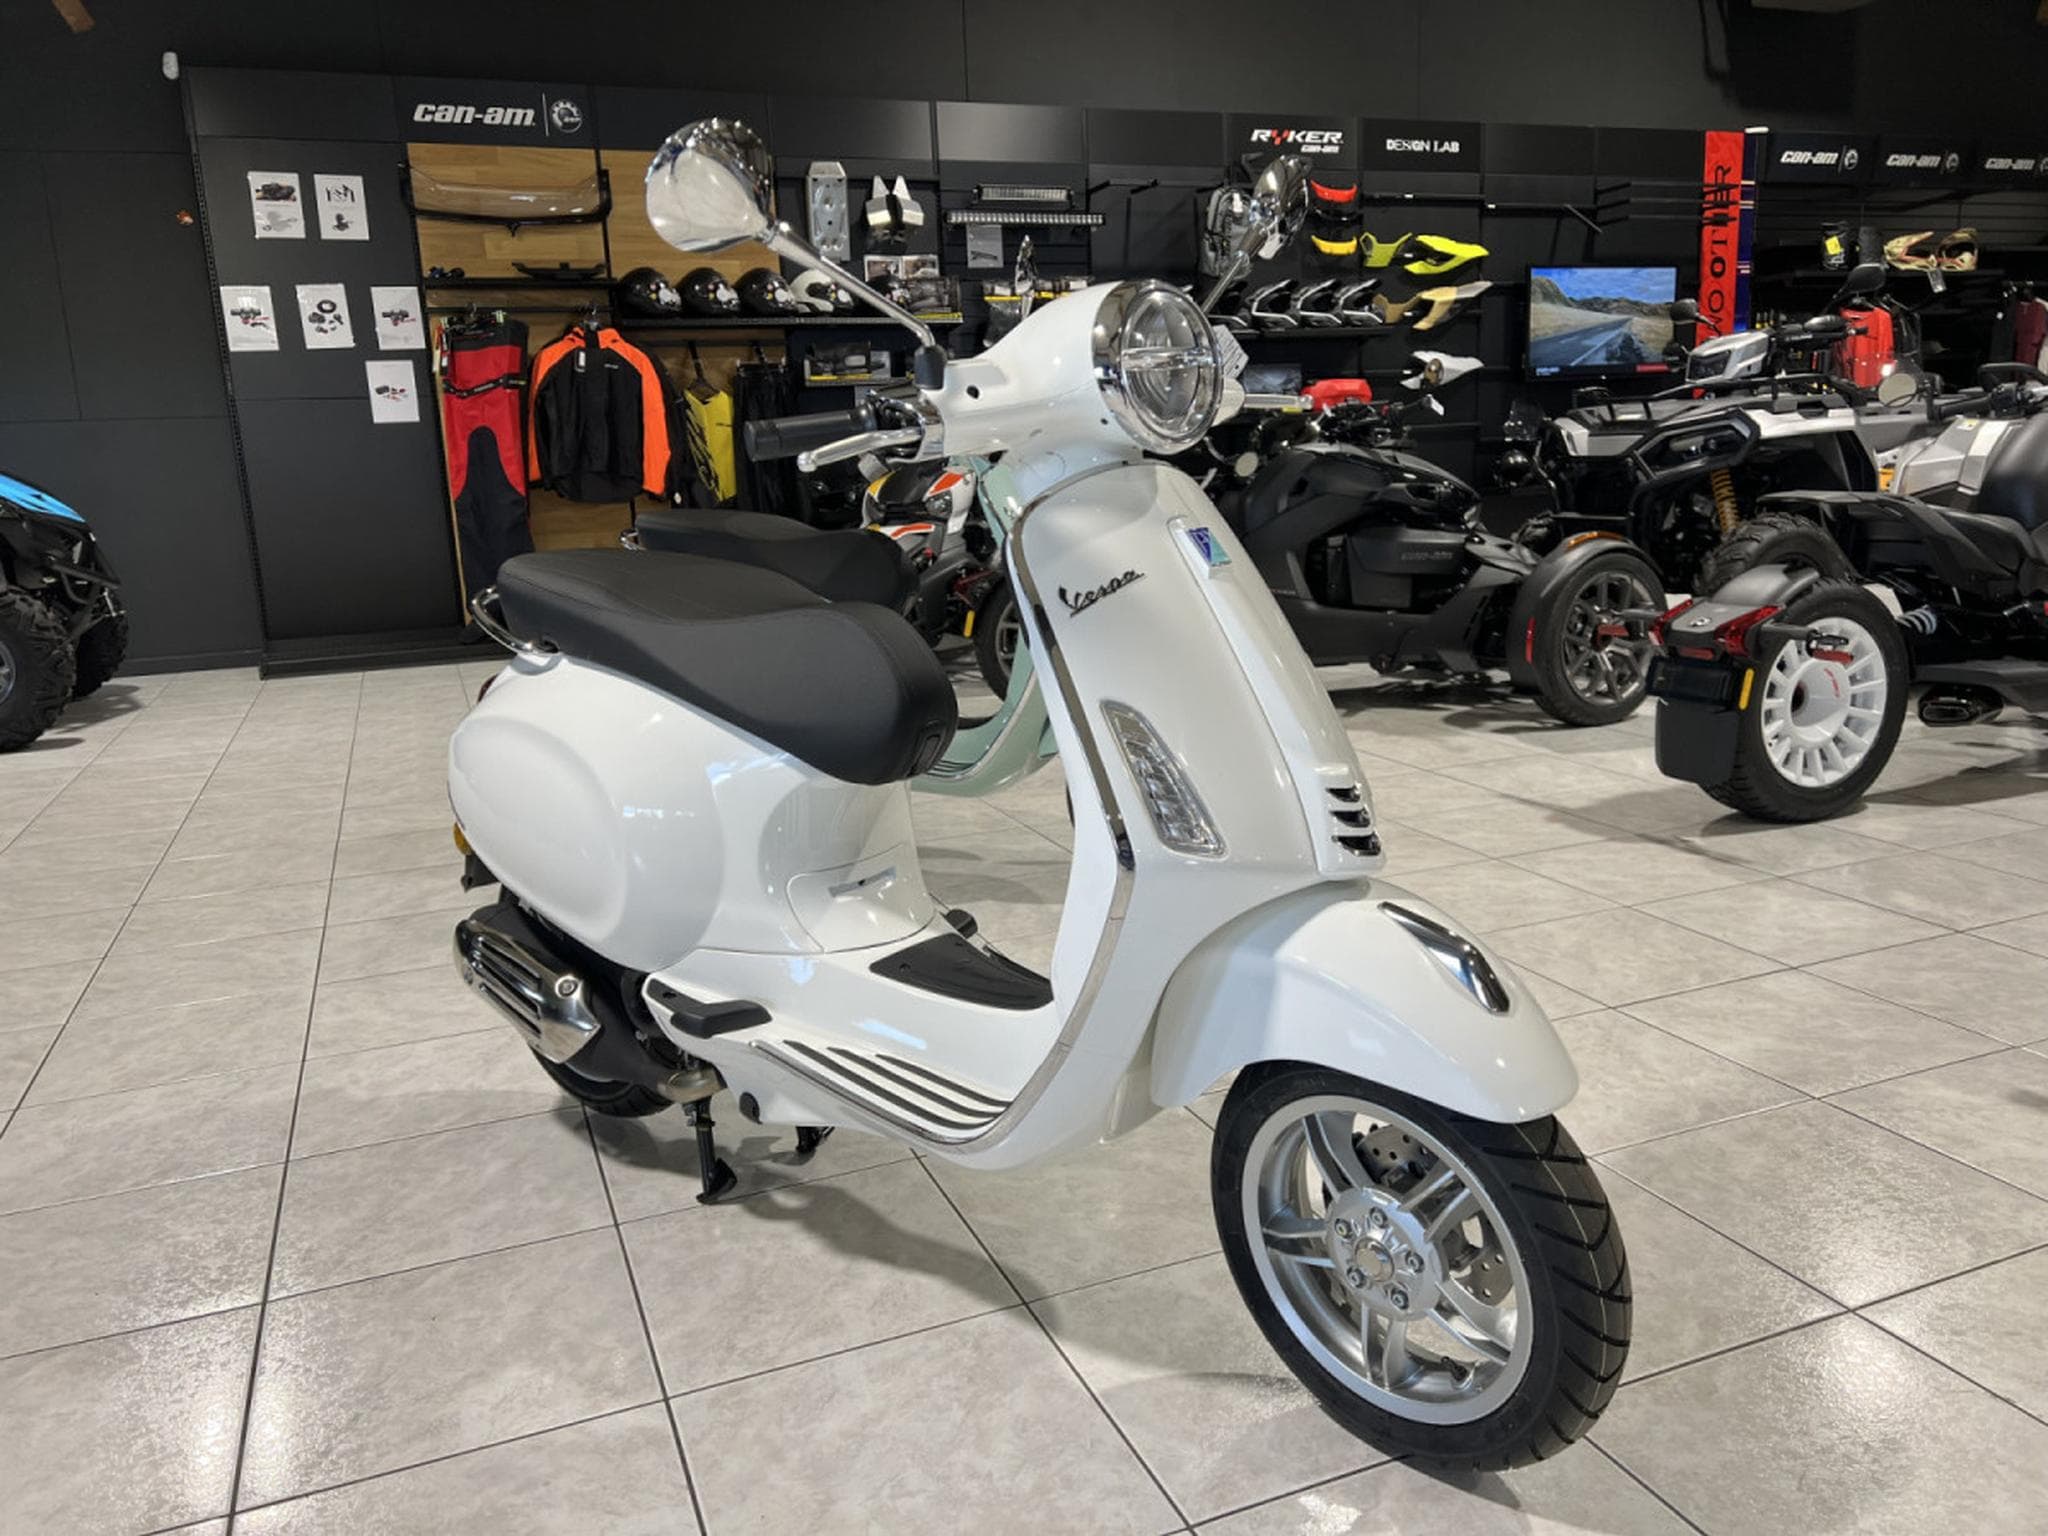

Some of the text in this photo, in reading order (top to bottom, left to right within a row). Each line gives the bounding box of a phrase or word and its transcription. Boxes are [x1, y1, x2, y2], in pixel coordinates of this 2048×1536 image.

[413, 103, 535, 126] can-am
[1250, 129, 1342, 146] RYKER
[1386, 138, 1460, 153] DESIGN LAB
[1780, 150, 1838, 165] can-am
[1886, 154, 1941, 168] can-am
[1985, 157, 2035, 170] can-am
[1058, 569, 1144, 618] Vespa
